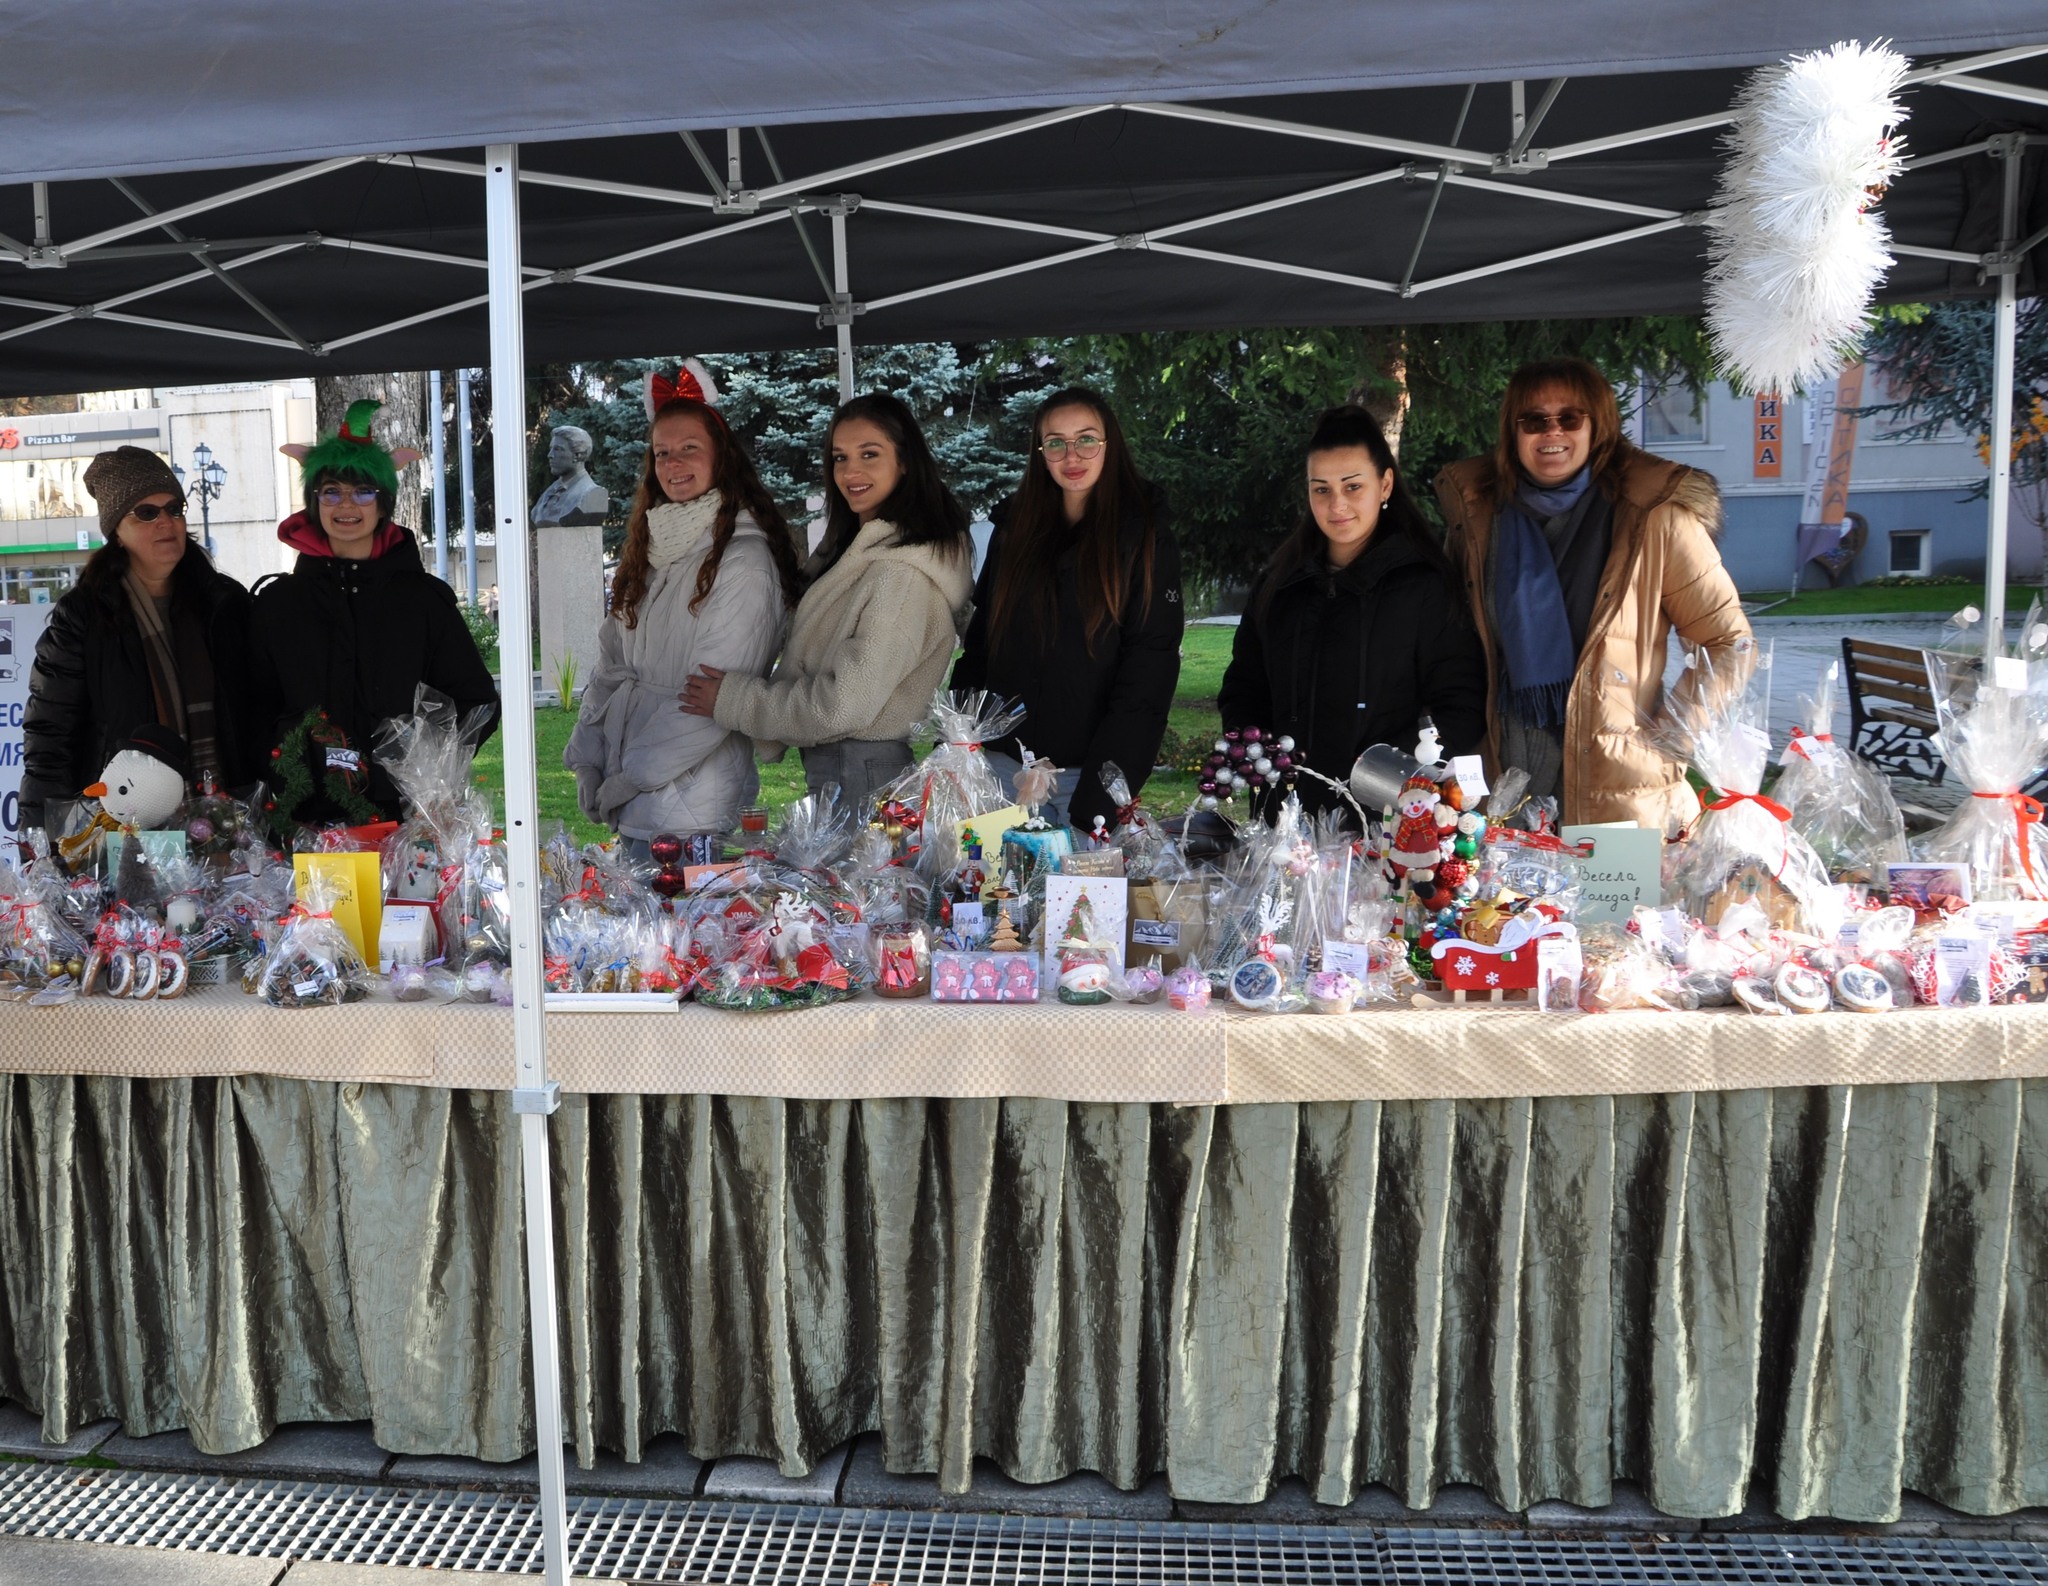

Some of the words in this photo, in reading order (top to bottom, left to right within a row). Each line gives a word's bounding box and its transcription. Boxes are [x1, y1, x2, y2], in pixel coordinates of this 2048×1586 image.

[28, 436, 52, 445] Pizza
[61, 435, 77, 443] Bar
[1578, 865, 1636, 881] Весела
[731, 911, 754, 920] XMAS
